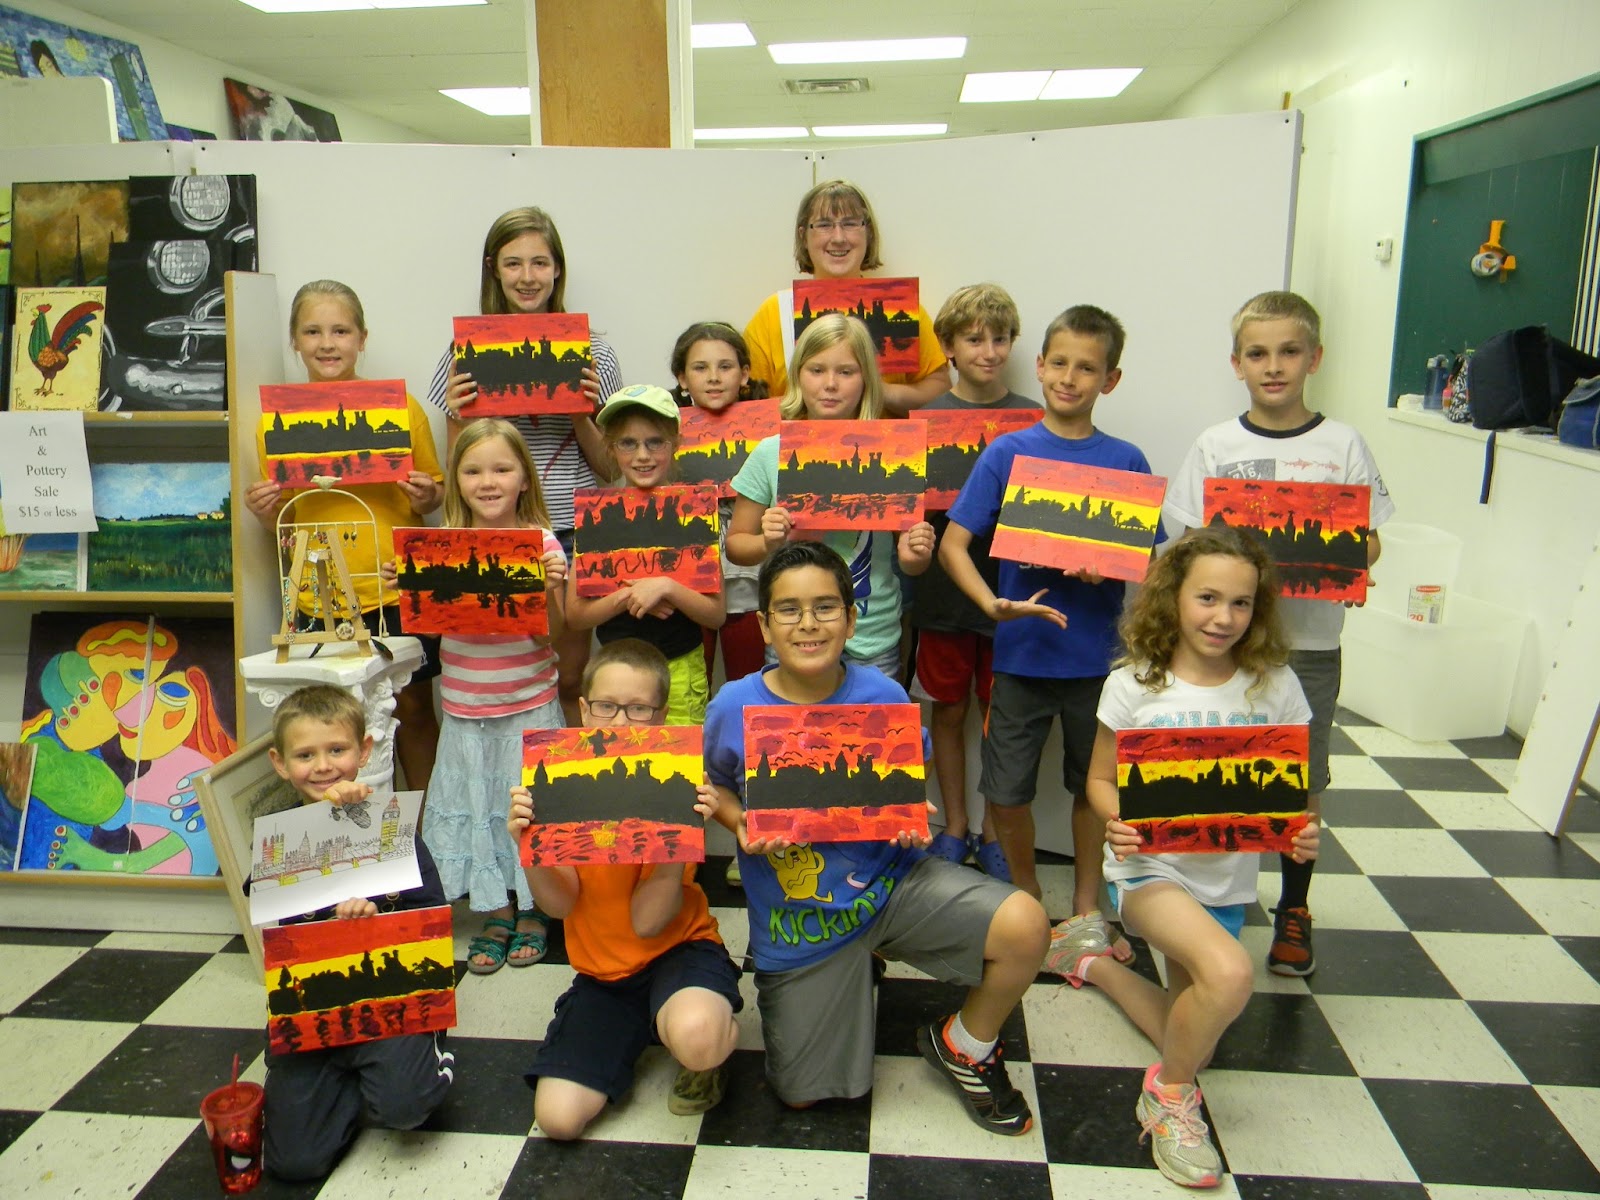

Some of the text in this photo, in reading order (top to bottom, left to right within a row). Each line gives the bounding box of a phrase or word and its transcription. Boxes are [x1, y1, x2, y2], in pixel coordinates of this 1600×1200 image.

[29, 425, 47, 437] Art
[37, 445, 47, 456] &
[26, 464, 67, 478] Pottery
[34, 486, 59, 498] Sale
[19, 506, 40, 518] $15
[55, 506, 77, 517] less
